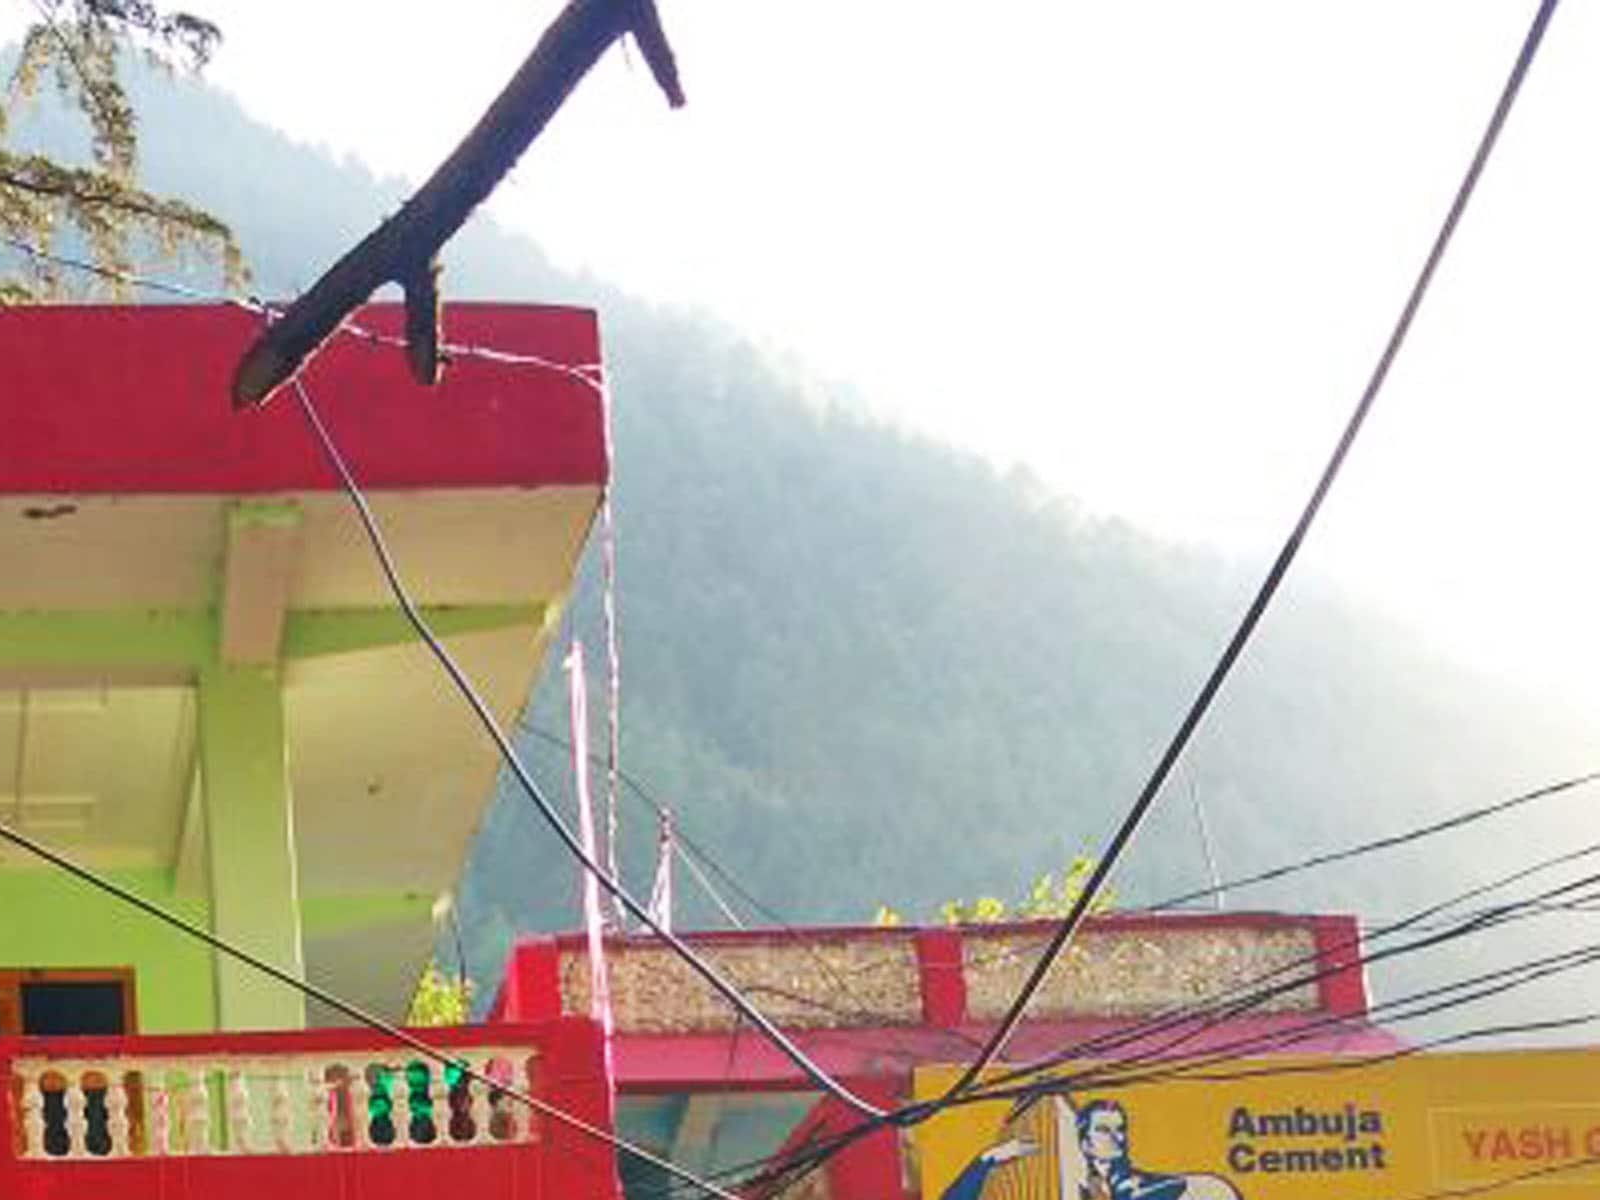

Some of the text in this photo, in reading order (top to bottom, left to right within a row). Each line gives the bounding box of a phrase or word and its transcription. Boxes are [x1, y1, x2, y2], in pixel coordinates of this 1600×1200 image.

[1227, 1105, 1382, 1143] Ambuja
[1227, 1143, 1386, 1175] Cement
[1461, 1126, 1572, 1161] YASH
